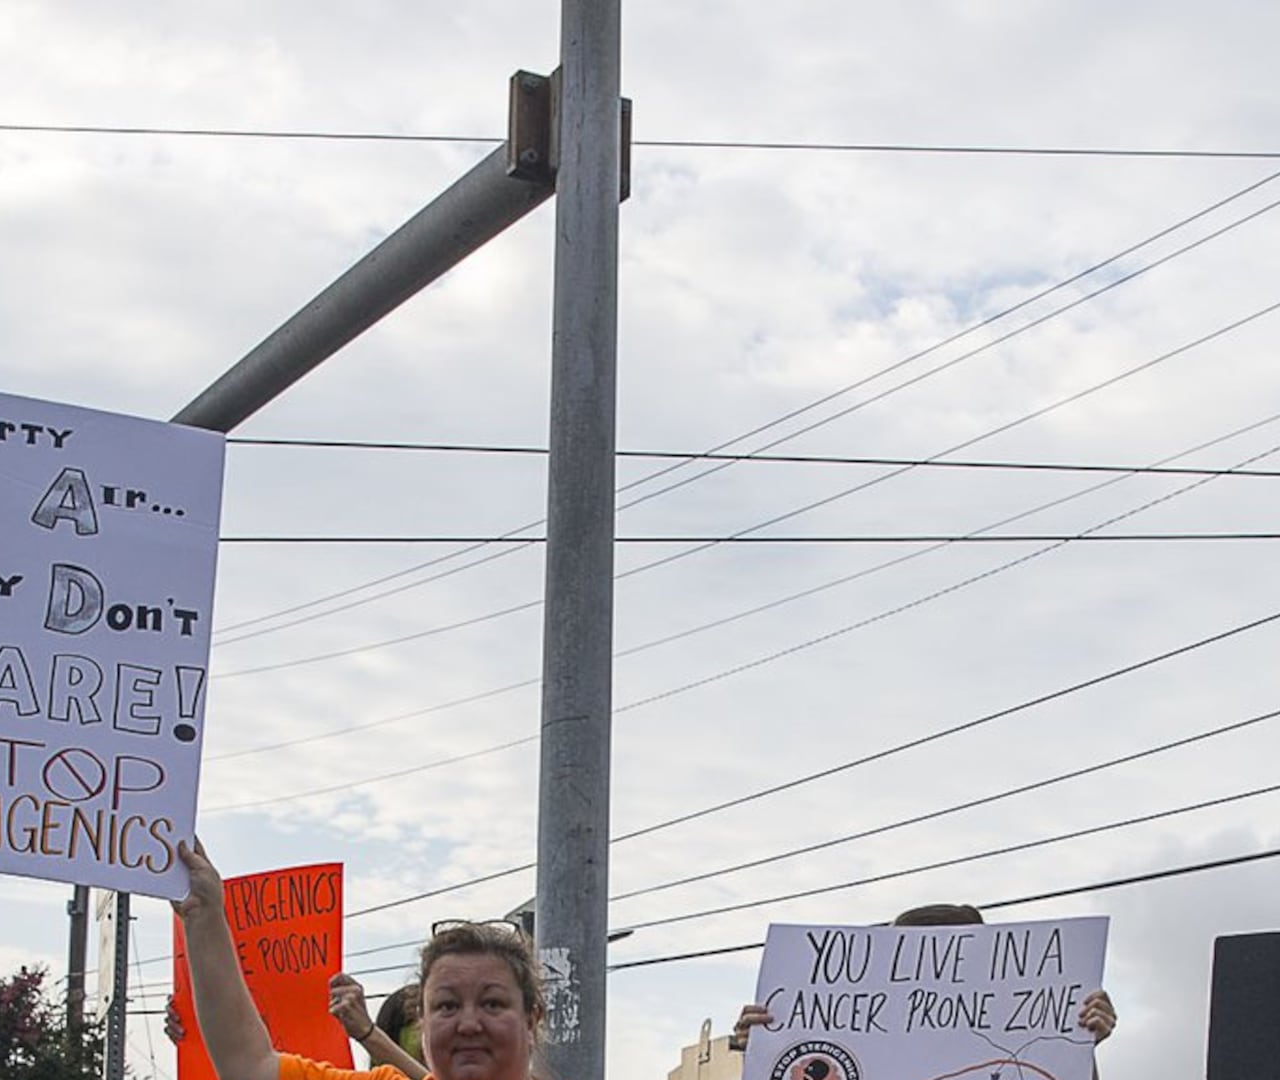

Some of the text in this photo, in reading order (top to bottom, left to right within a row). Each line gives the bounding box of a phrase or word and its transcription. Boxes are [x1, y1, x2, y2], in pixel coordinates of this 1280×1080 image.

[224, 871, 340, 932] ERIGENICS
[257, 932, 331, 974] POISON
[806, 928, 1064, 985] YOU LIVE IN A
[764, 983, 1082, 1035] CANCER PRONE ZONE
[773, 1049, 797, 1075] STOP
